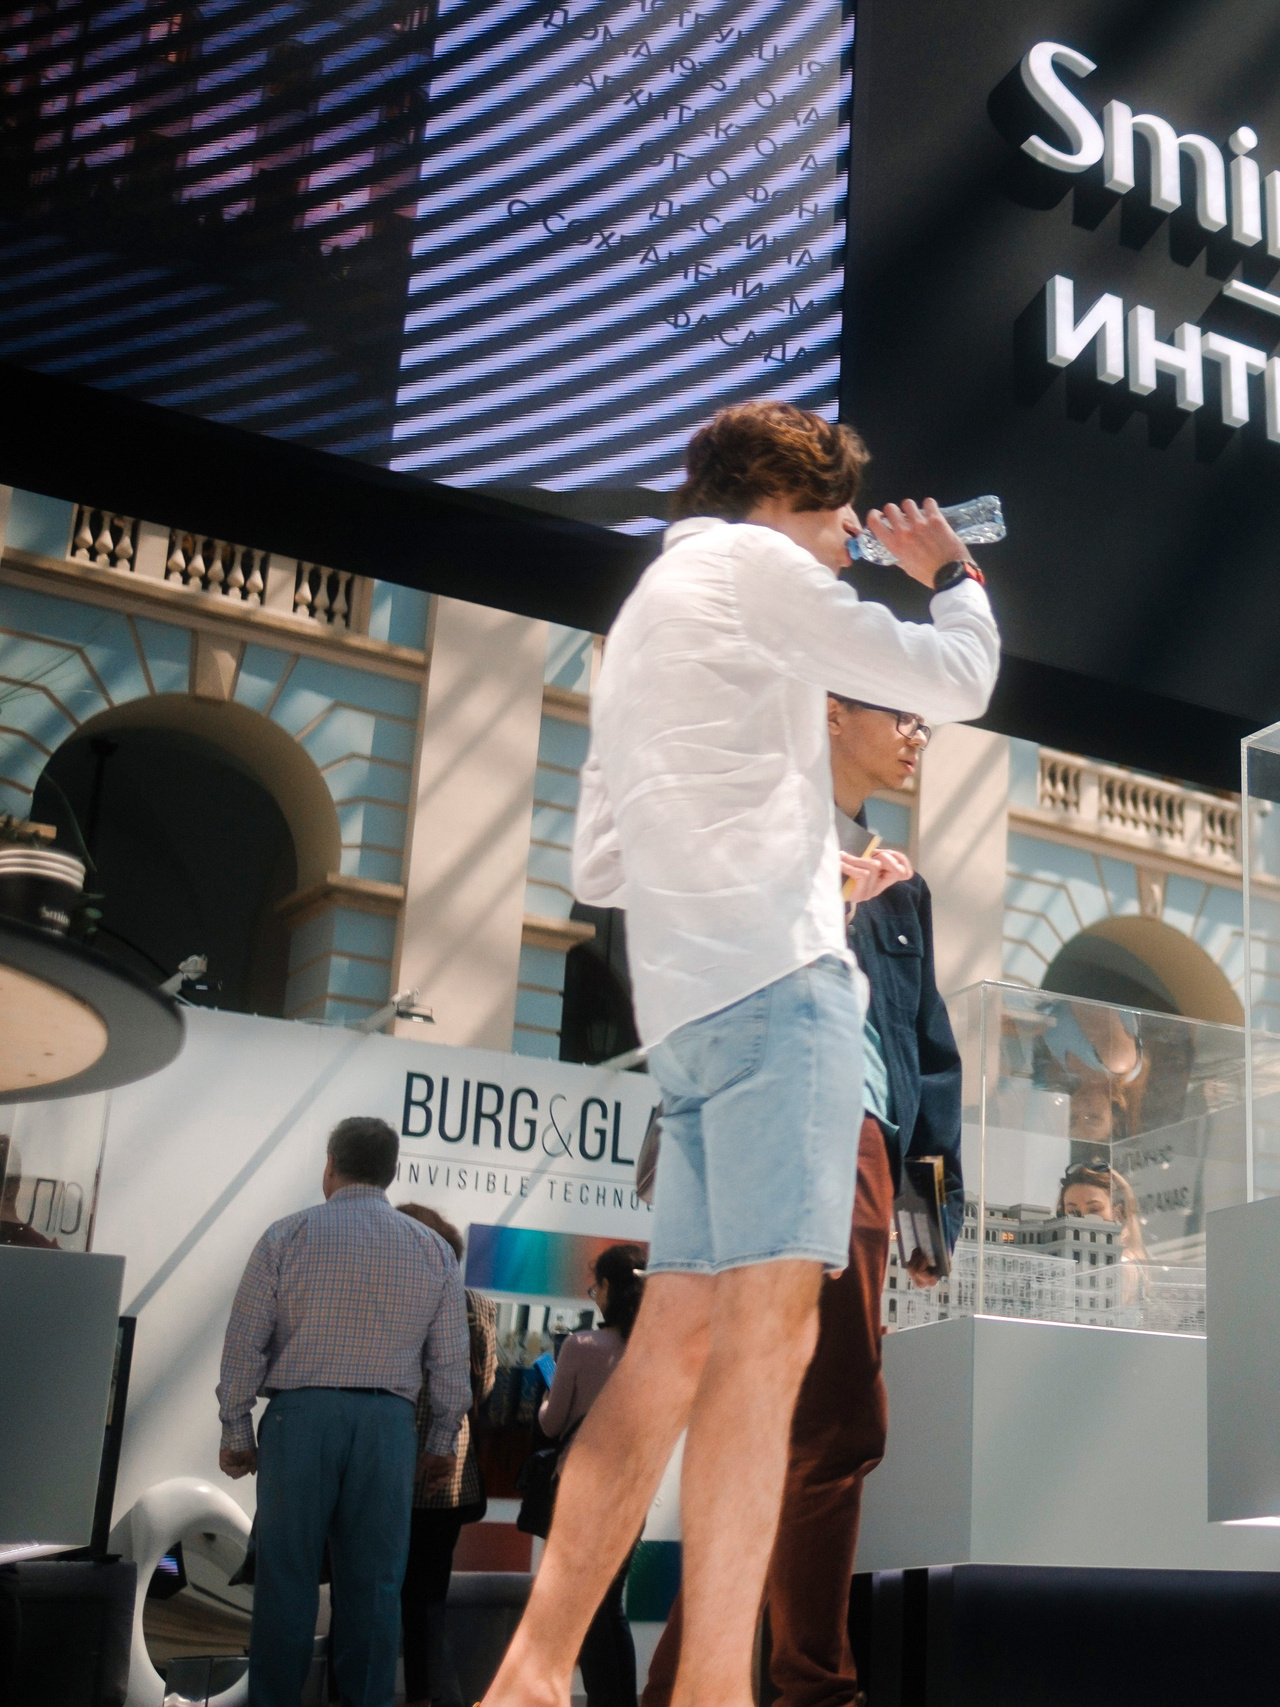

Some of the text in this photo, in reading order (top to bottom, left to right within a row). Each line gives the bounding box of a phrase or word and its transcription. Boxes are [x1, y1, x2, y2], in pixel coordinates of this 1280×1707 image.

[574, 71, 818, 173] АХТКОА
[648, 198, 814, 267] ДСИА
[397, 1161, 531, 1199] INVISIBLE
